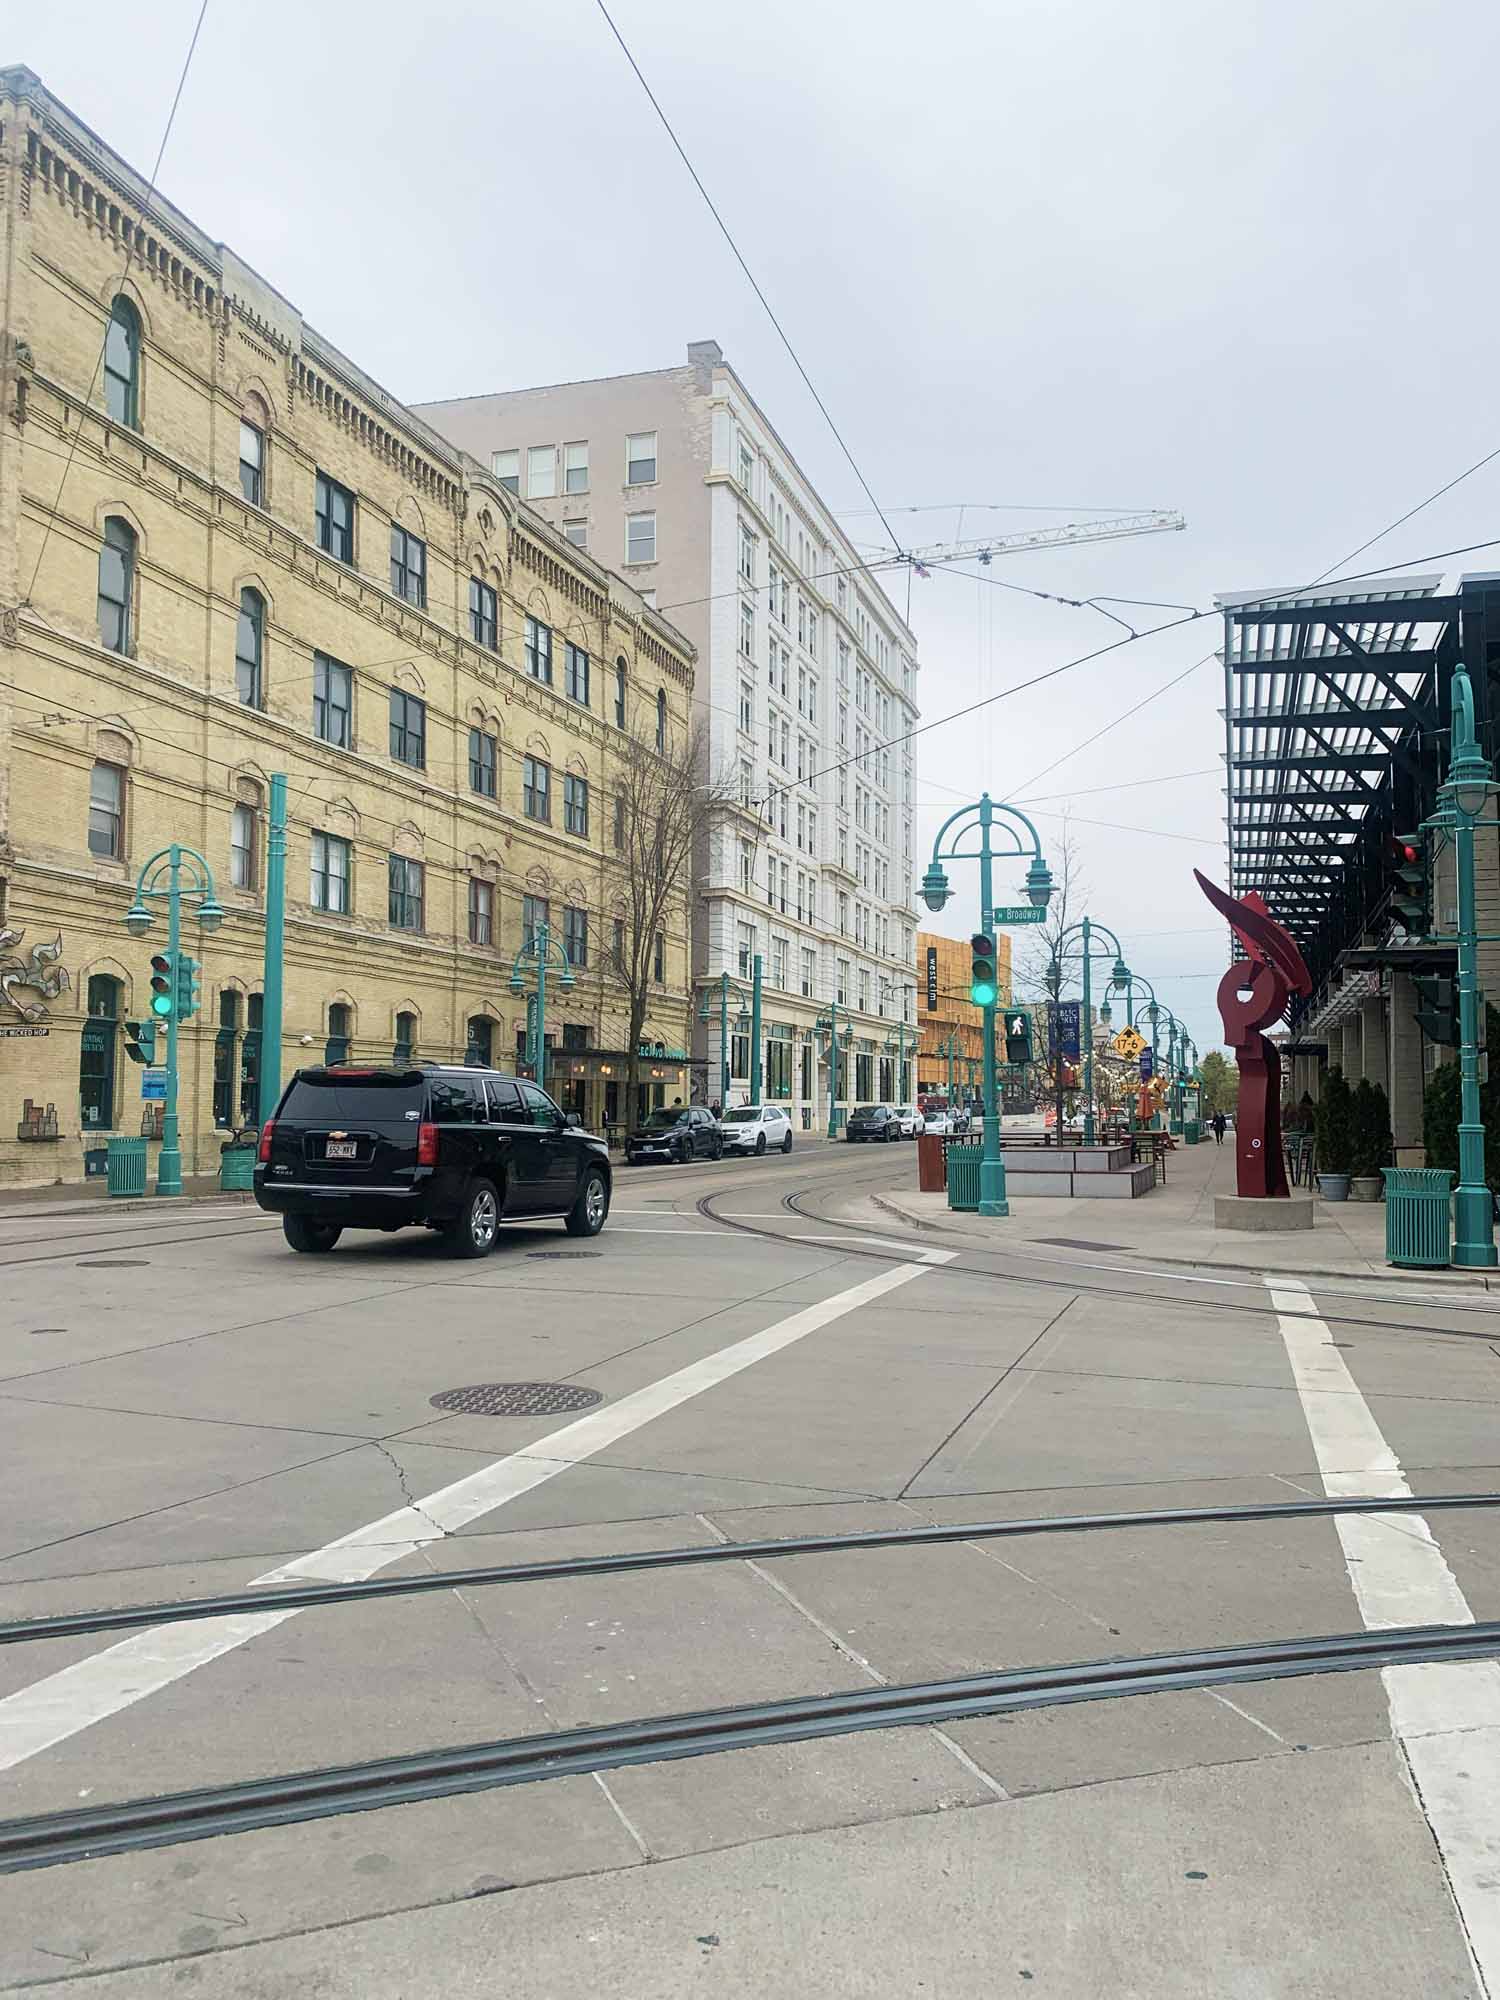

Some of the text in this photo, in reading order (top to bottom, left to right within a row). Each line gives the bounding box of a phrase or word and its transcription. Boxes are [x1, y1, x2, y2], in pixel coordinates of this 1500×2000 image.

[1006, 908, 1041, 922] Broadway
[929, 958, 938, 1001] west elm
